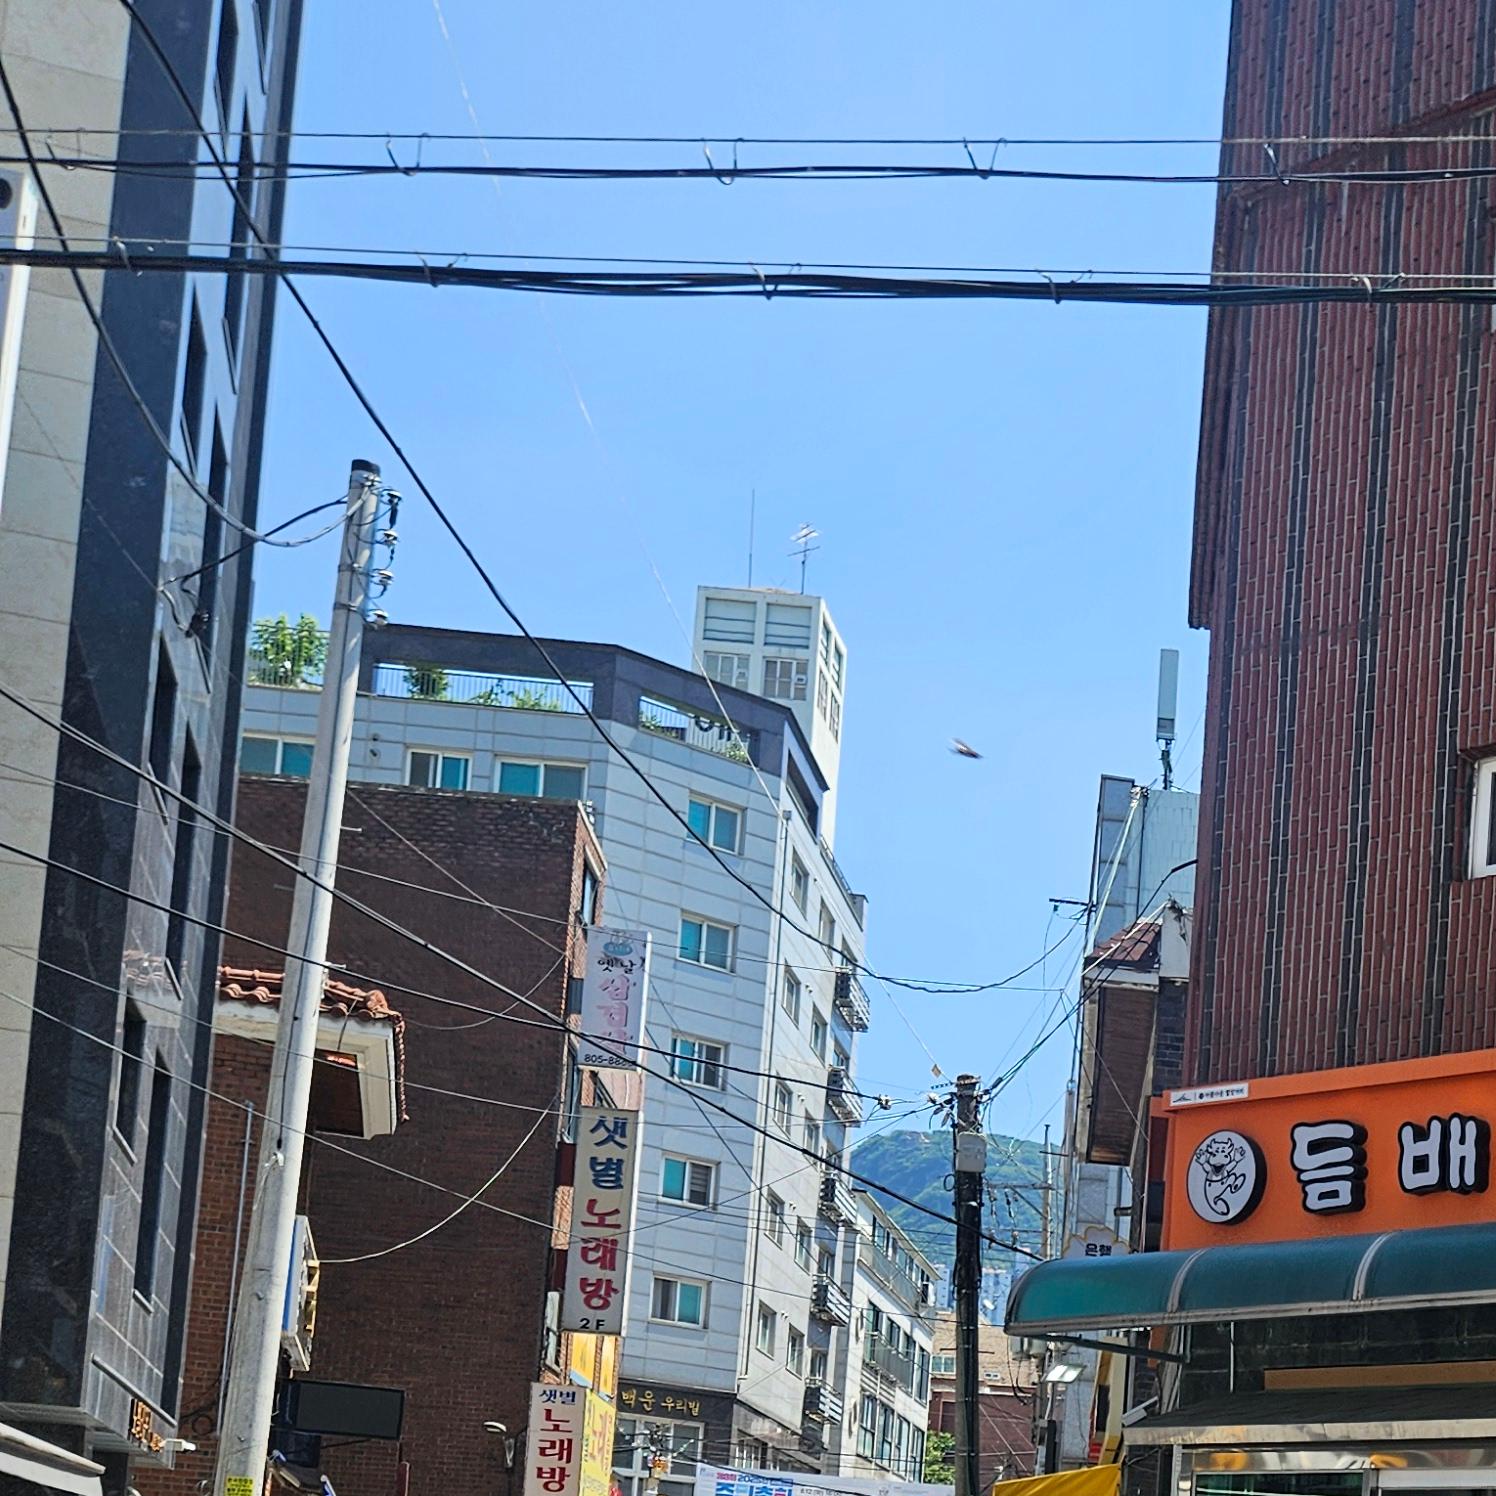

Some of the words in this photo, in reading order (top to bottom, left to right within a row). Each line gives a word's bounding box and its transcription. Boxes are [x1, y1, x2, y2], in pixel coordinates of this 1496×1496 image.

[584, 1053, 637, 1068] 805-88
[588, 1116, 628, 1190] 샛별
[580, 1199, 622, 1311] 노래방
[538, 1389, 577, 1405] 샛별
[621, 1388, 656, 1412] 백운
[660, 1396, 700, 1417] 우리빌
[536, 1408, 573, 1493] 노래방
